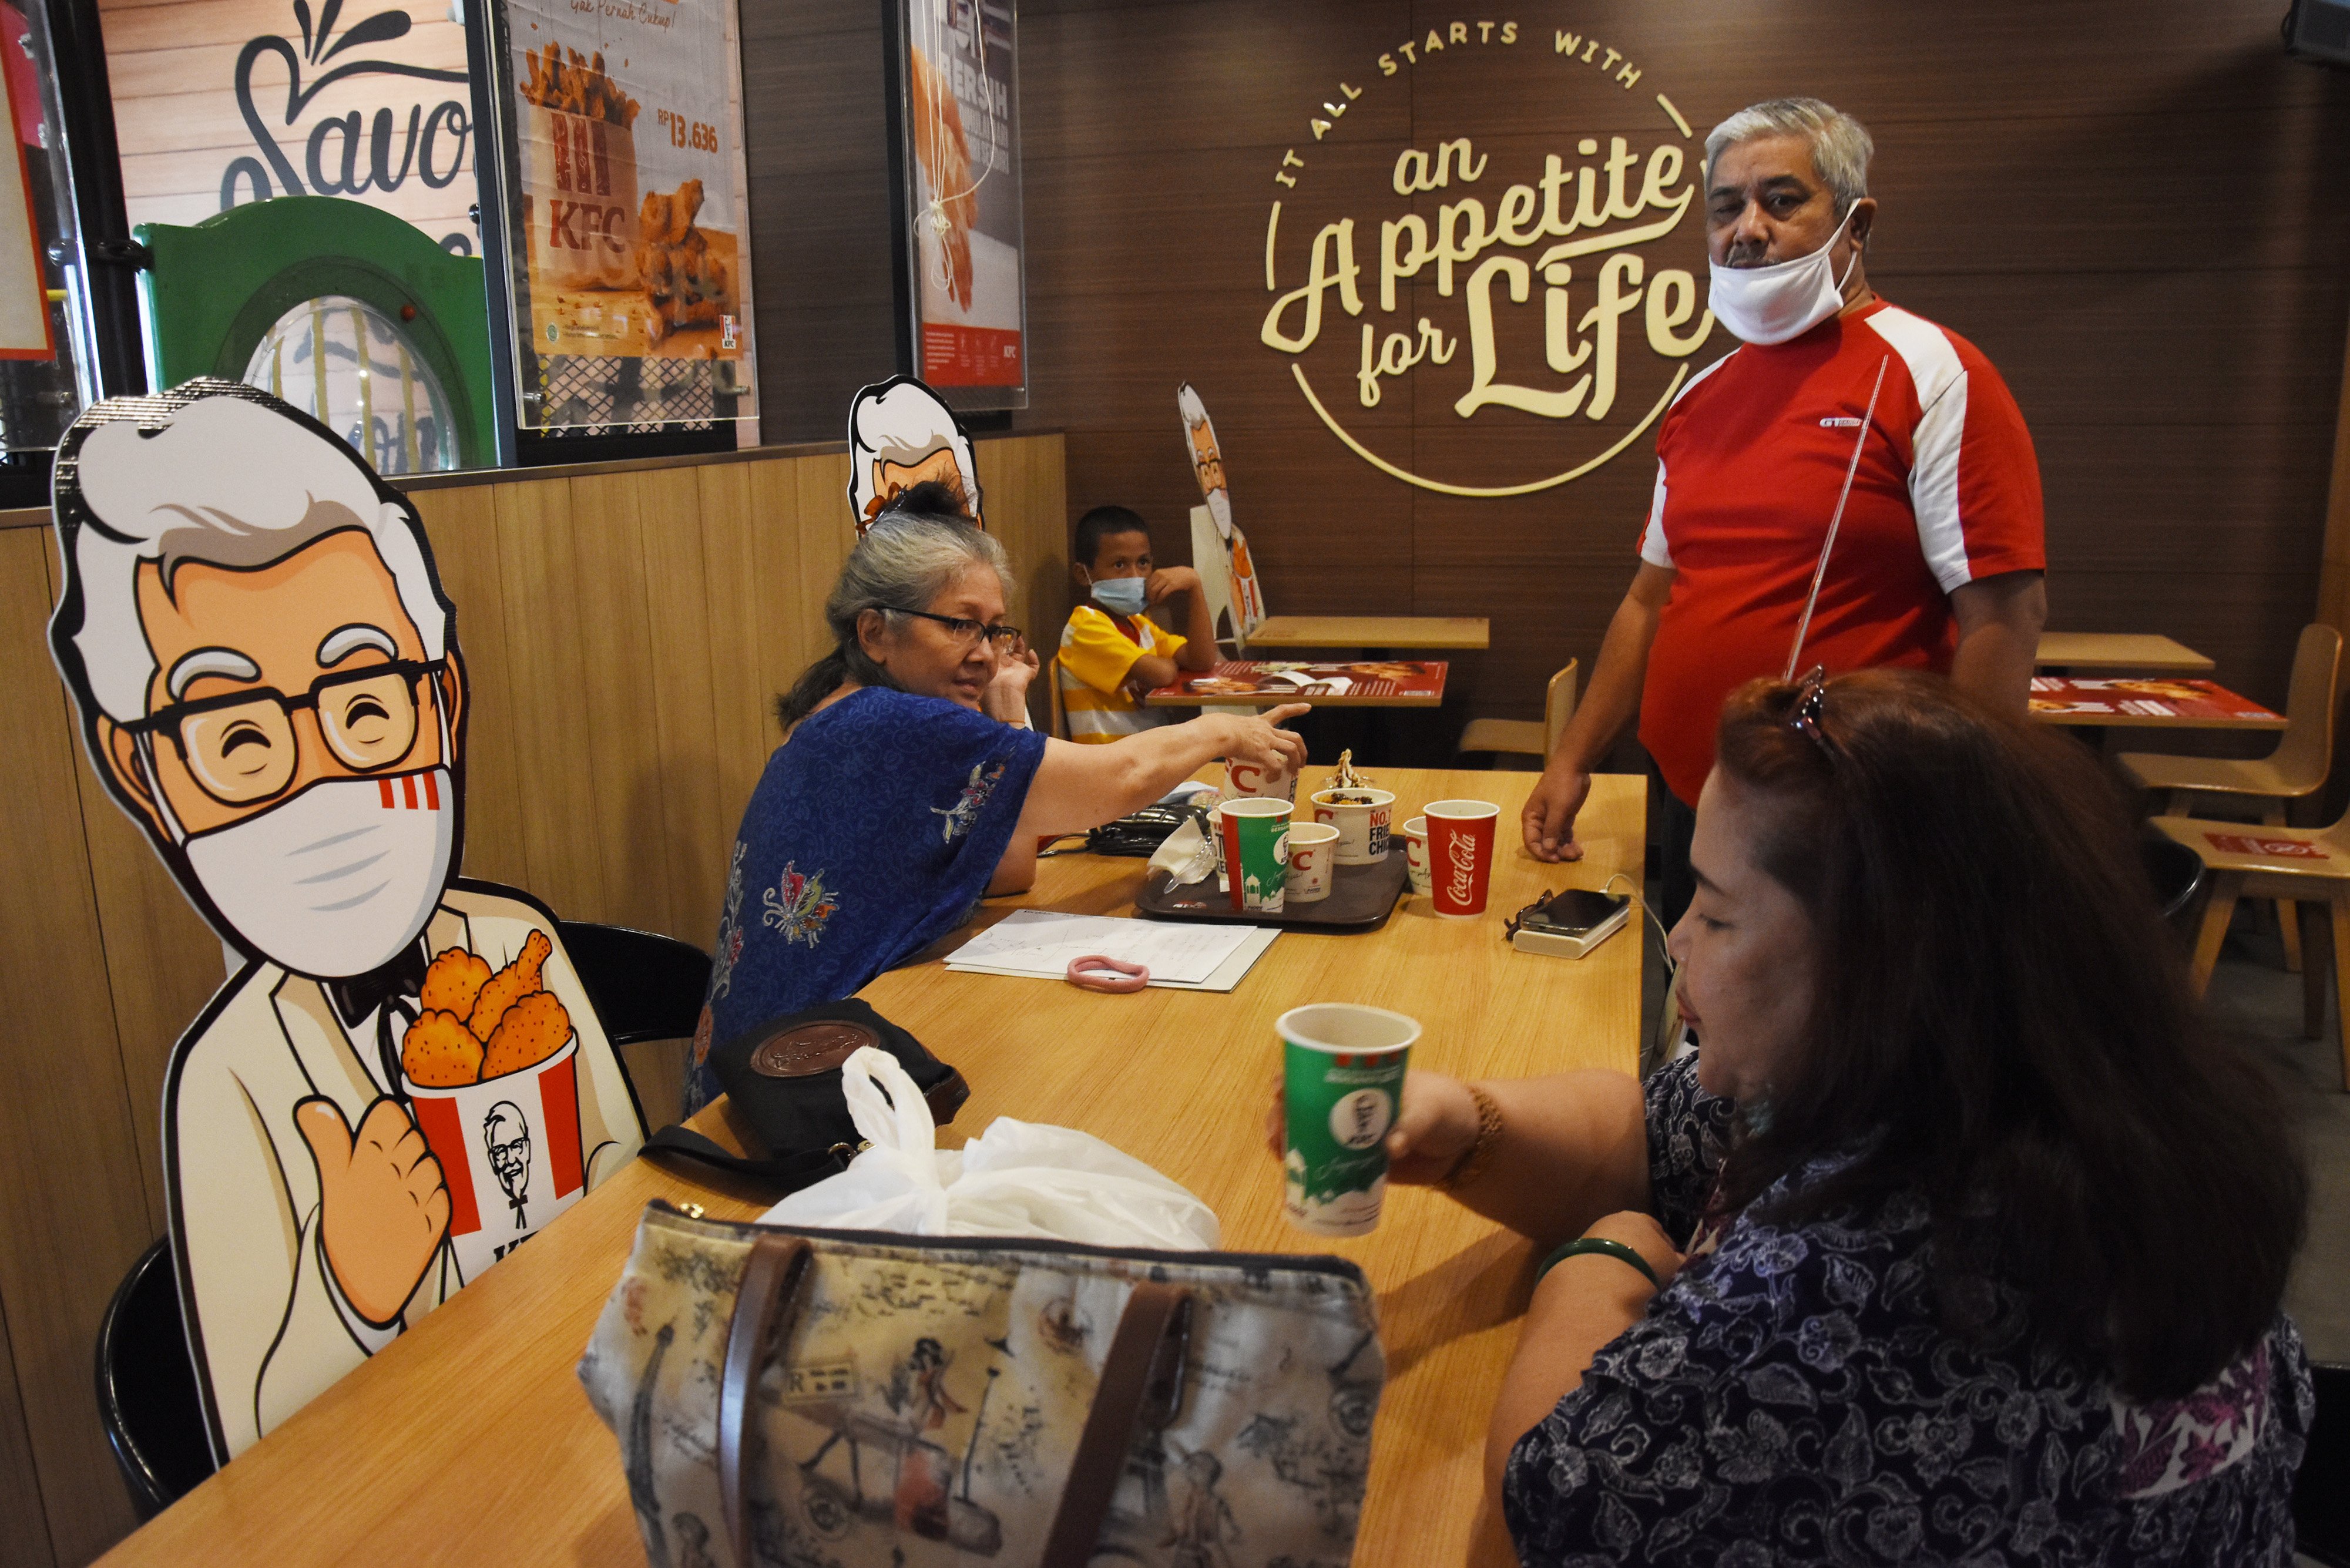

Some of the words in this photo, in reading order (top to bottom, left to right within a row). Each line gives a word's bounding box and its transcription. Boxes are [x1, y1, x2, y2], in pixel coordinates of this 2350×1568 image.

[1275, 149, 1304, 188] IT
[1310, 82, 1362, 140] ALL
[1378, 21, 1518, 76] STARTS
[1555, 30, 1642, 89] WITH
[1393, 137, 1488, 195] an
[549, 199, 626, 253] KFC
[1261, 136, 1695, 353] Appetite
[1357, 317, 1457, 407] for
[1454, 252, 1716, 421] Life
